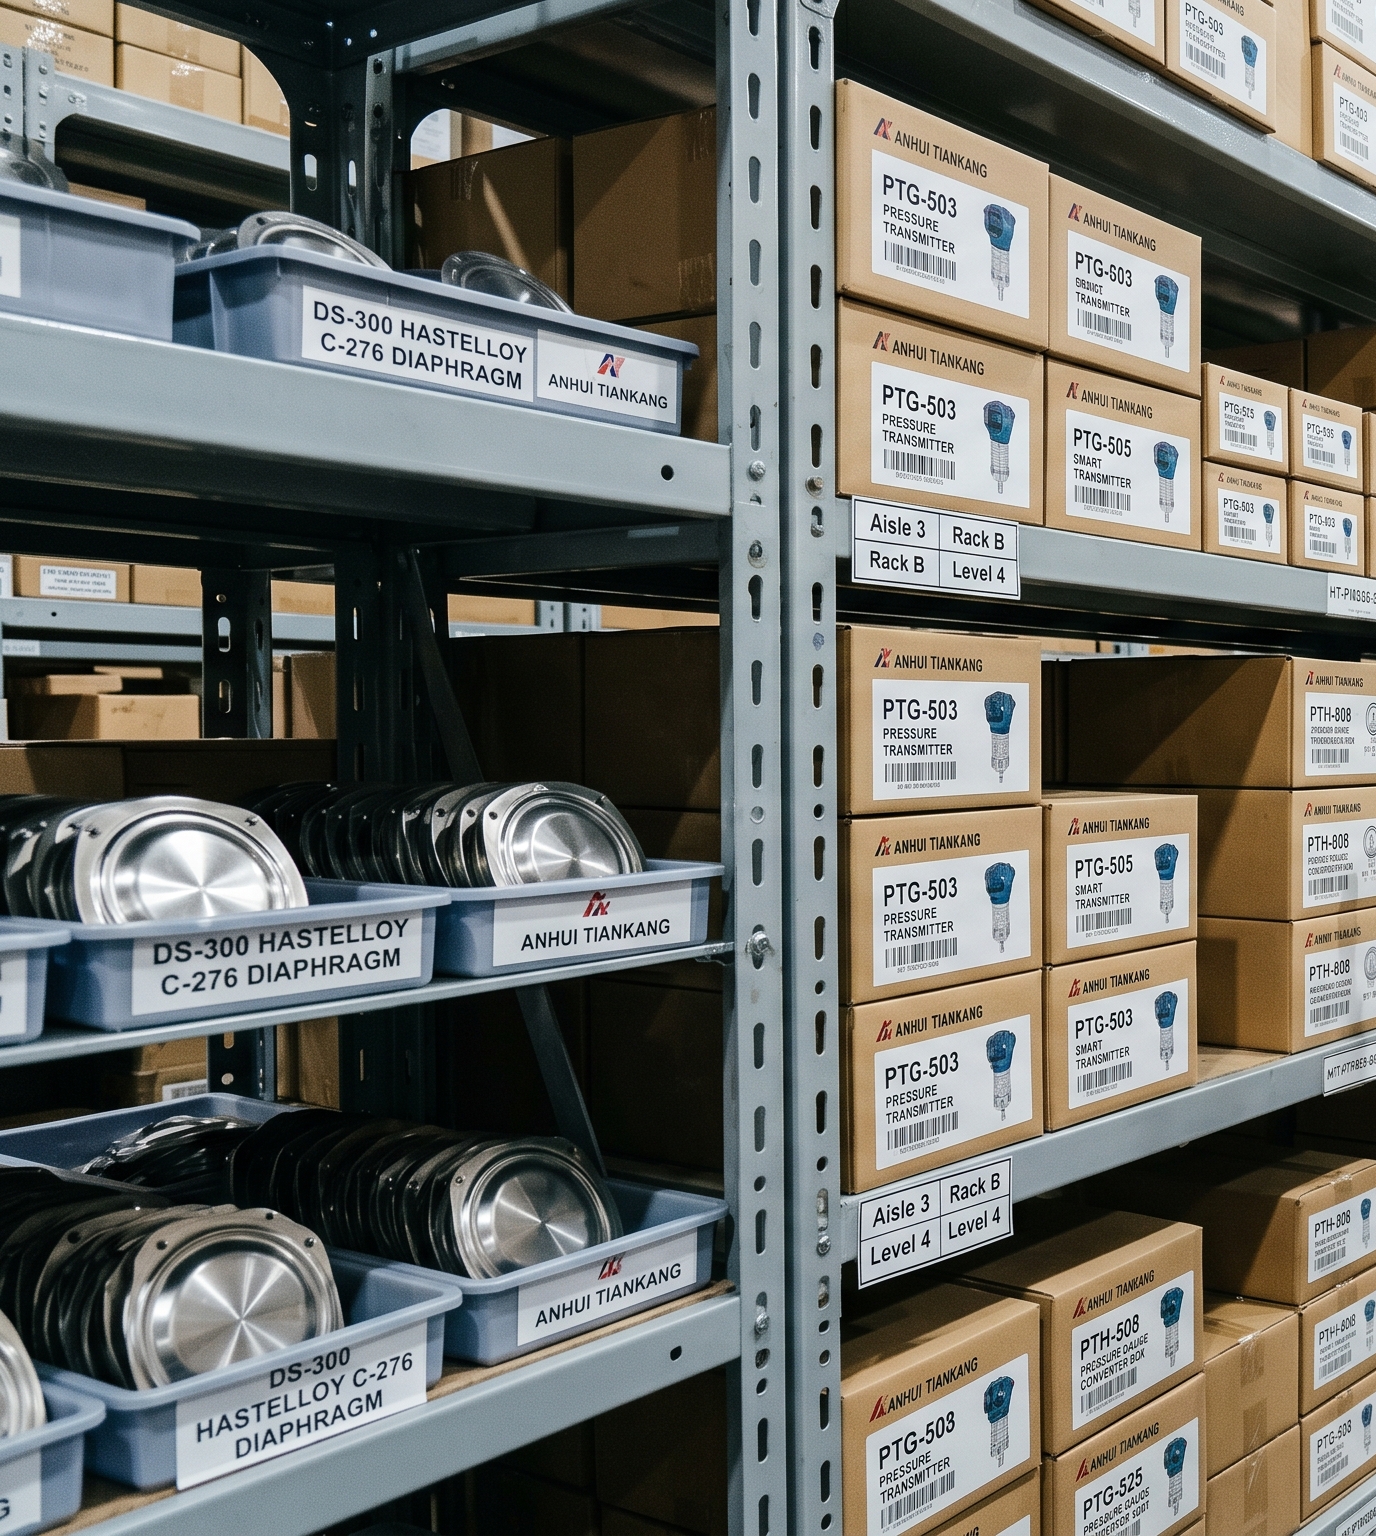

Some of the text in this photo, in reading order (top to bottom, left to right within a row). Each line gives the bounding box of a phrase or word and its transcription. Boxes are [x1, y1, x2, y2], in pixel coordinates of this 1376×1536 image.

[895, 130, 988, 179] ANHUI TIANKANG
[883, 174, 958, 218] PTG-503
[883, 204, 940, 233] PRESSURE
[1083, 212, 1157, 252] ANHUI TIANKANG
[883, 221, 956, 255] TRANSMITTER
[1076, 291, 1131, 318] TRANSMITTER
[313, 300, 528, 365] DS-300 HASTELLOY
[320, 331, 523, 391] C-276 DIAPHRAGM
[892, 340, 985, 376] ANHUI TIANKANG
[547, 373, 669, 411] ANHUI TIANKANG
[882, 384, 957, 420] PTG-503
[1081, 389, 1154, 420] ANHUI TIANKANG
[882, 413, 937, 436] PRESSURE
[882, 429, 955, 455] TRANSMITTER
[1073, 427, 1132, 459] PTG-505
[1073, 453, 1103, 470] SMART
[1073, 468, 1132, 490] TRANSMITTER
[870, 513, 926, 539] Aisle 3
[952, 526, 1005, 551] Rack B
[870, 550, 925, 574] Rack B
[952, 560, 1006, 584] Level 4
[894, 654, 983, 673] ANHUI TIANKANG
[883, 698, 958, 721] PTG-503
[1310, 705, 1352, 723] PTH-808
[883, 727, 937, 740] PRESSURE
[883, 743, 953, 757] TRANSMITTER
[1082, 817, 1150, 835] ANHUI TIANKANG
[894, 832, 981, 855] ANHUI TIANKANG
[1075, 854, 1133, 879] PTG-505
[884, 877, 958, 907] PTG-503
[1075, 882, 1103, 896] SMART
[884, 907, 938, 926] PRESSURE
[884, 921, 955, 942] TRANSMITTER
[152, 917, 411, 966] DS-300 HASTELLOY
[520, 918, 671, 952] ANHUI TIANKANG
[160, 947, 403, 997] C-276 DIAPHRAGM
[1082, 968, 1150, 995] ANHUI TIANKANG
[1309, 958, 1351, 982] PTH-808
[895, 1005, 984, 1038] ANHUI TIANKANG
[1075, 1008, 1134, 1040] PTG-503
[1075, 1039, 1103, 1056] SMART
[1076, 1046, 1131, 1070] TRANSMITTER
[885, 1051, 959, 1089] PTG-503
[885, 1084, 938, 1109] PRESSURE
[886, 1096, 954, 1125] TRANSMITTER
[949, 1172, 1001, 1204] Rack B
[872, 1193, 931, 1228] Aisle 3
[949, 1206, 1001, 1241] Level 4
[870, 1230, 931, 1266] Level 4
[535, 1261, 683, 1329] ANHUI TIANKANG
[1087, 1269, 1155, 1312] ANHUI TIANKANG
[1080, 1313, 1140, 1360] PTH-508
[268, 1345, 352, 1390] DS-300
[1080, 1347, 1121, 1378] PRESSURE
[1080, 1347, 1146, 1391] CONVENTER BOX
[195, 1351, 414, 1444] HASTELLOY C-276
[887, 1356, 979, 1412] ANHUI TIANKANG
[235, 1388, 384, 1460] DIAPHRAGM
[878, 1410, 956, 1470] PTG-503
[879, 1450, 932, 1488] PRESSURE
[1090, 1445, 1117, 1472] ANHUI
[880, 1456, 951, 1504] TRANSMITTER
[1083, 1466, 1143, 1520] PTG-525
